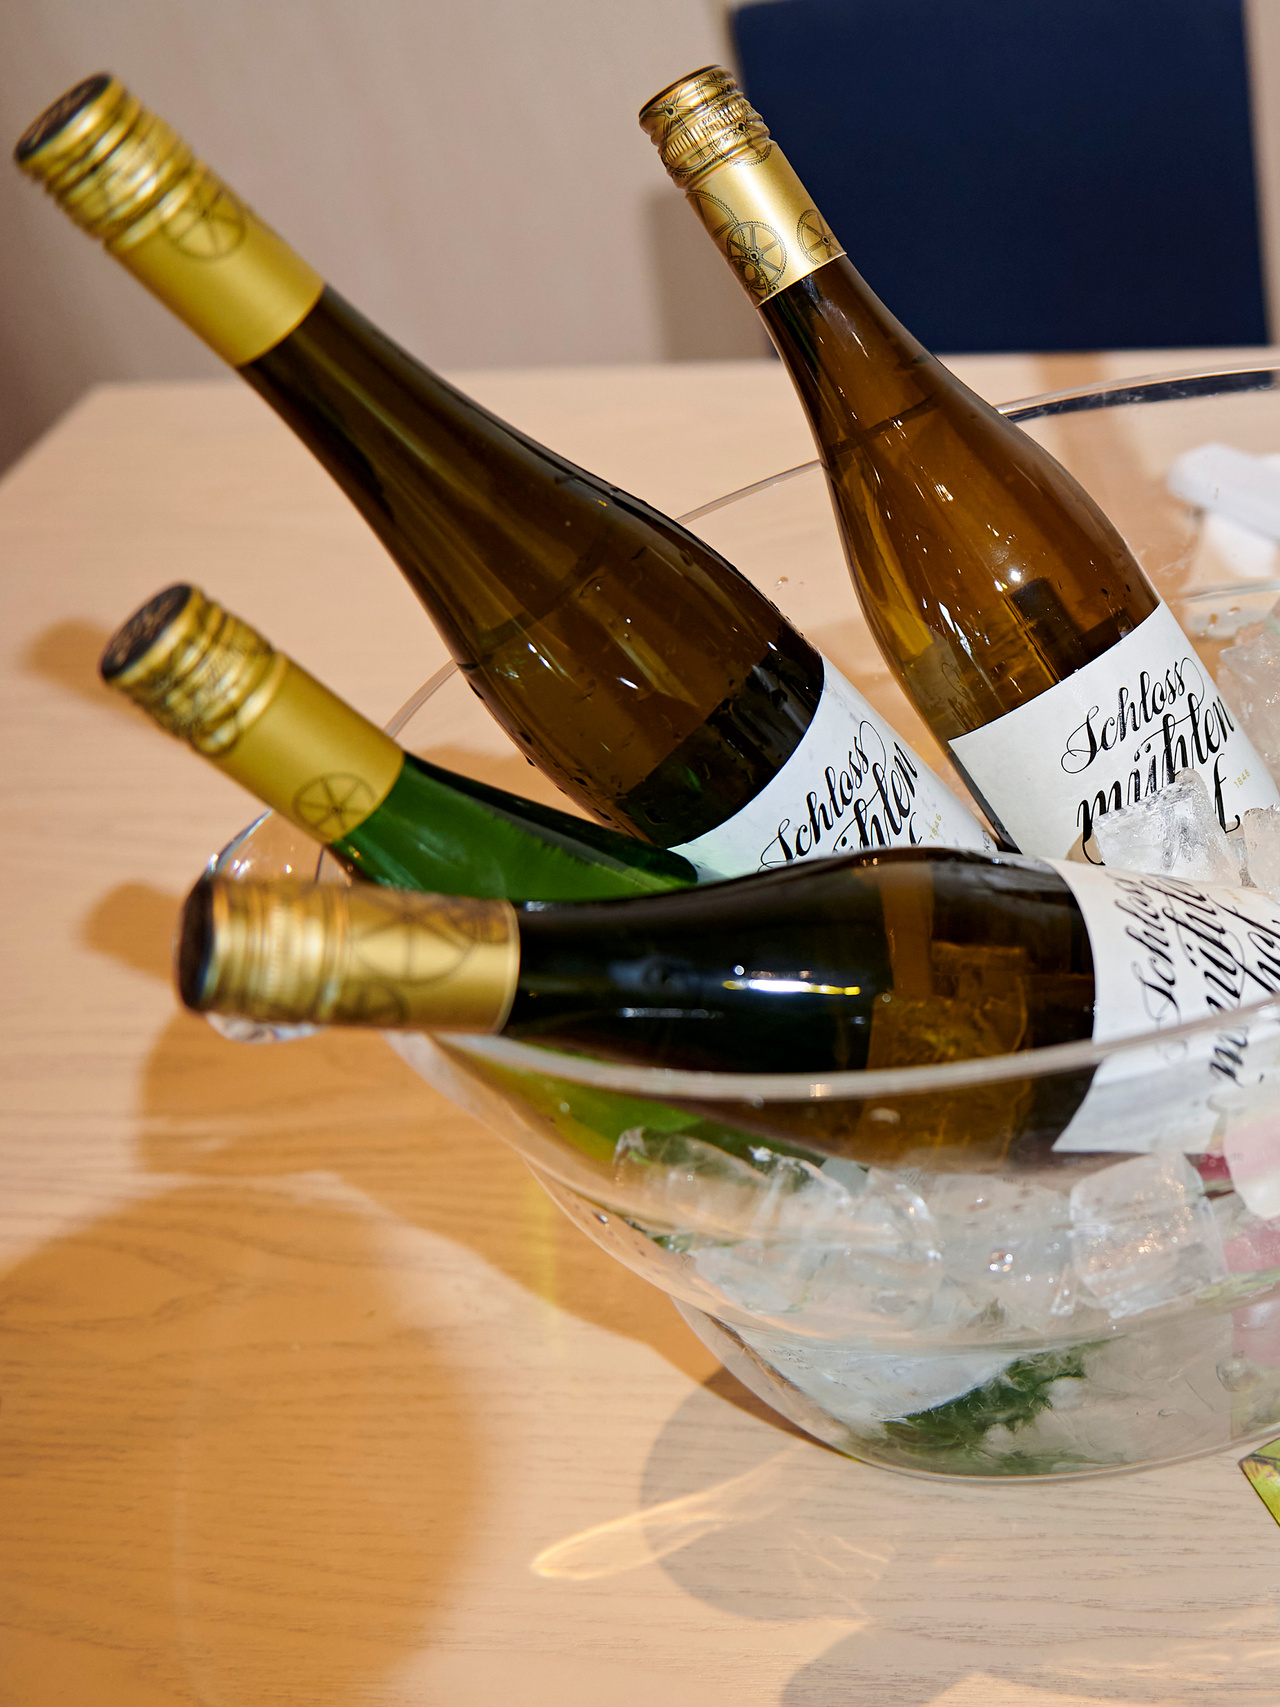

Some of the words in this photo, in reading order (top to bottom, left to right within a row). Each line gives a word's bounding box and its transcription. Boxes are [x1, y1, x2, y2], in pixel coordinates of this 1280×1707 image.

[1061, 657, 1205, 775] Schloss
[758, 720, 886, 872] Schloss
[1232, 768, 1252, 789] 1846
